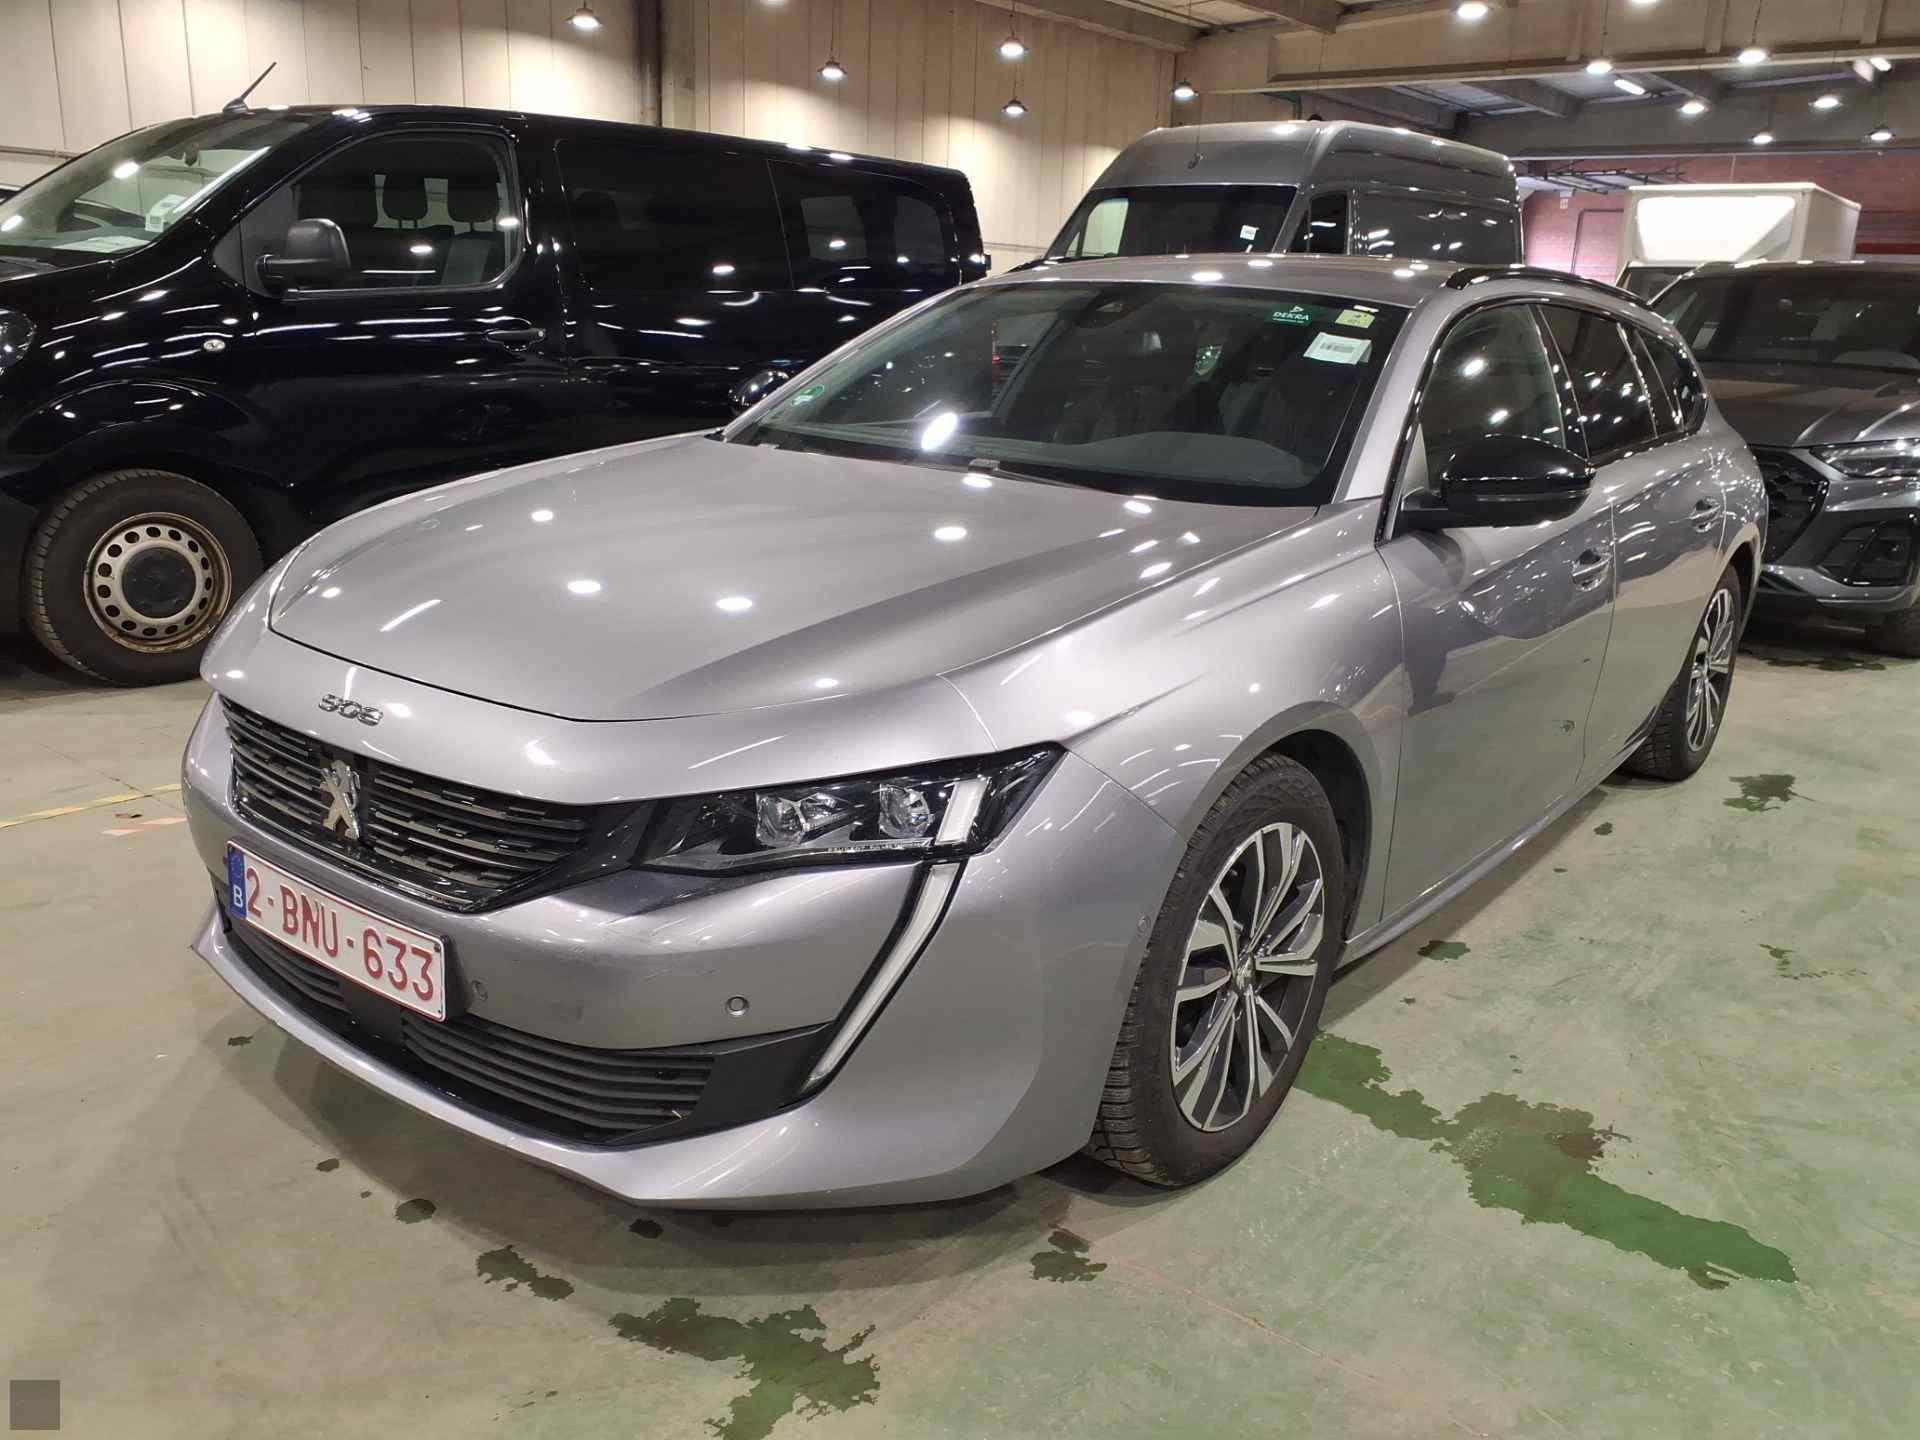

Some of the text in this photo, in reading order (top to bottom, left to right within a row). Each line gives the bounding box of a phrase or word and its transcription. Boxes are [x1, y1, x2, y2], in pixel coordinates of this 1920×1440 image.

[1272, 311, 1309, 321] DEKRA
[318, 693, 384, 727] 508
[232, 884, 243, 907] B
[246, 867, 434, 1001] 2-BNU-633
